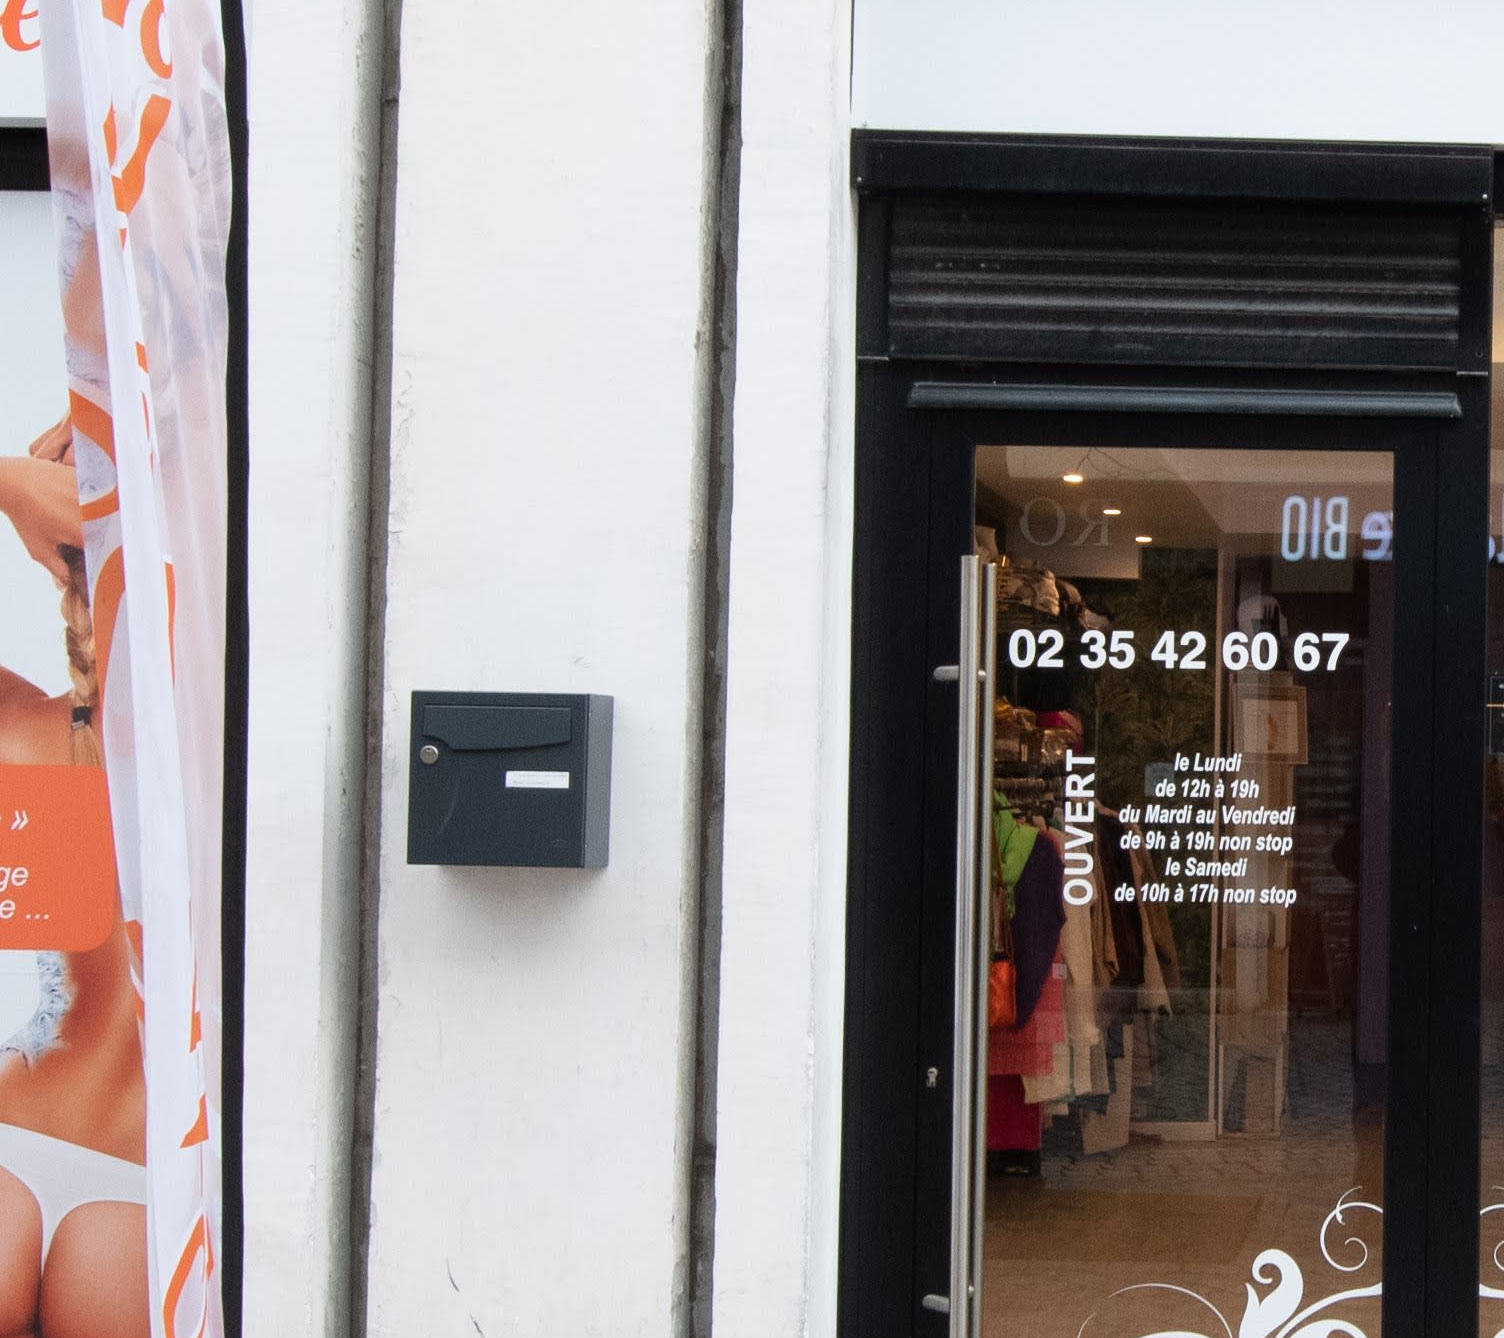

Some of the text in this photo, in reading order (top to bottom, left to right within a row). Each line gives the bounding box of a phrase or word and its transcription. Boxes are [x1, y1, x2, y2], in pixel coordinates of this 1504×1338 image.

[1010, 629, 1349, 671] 02 35 42 60 67
[1174, 752, 1242, 772] le Lundi
[1155, 779, 1259, 798] de 12h à 19h
[1119, 804, 1296, 825] du Mardi au Vendredi
[1064, 750, 1095, 905] OUVERT
[1120, 830, 1293, 855] de 9h à 19h non stop
[1165, 857, 1247, 876] le Samedi
[1114, 883, 1297, 908] de 10h à 17h non stop
